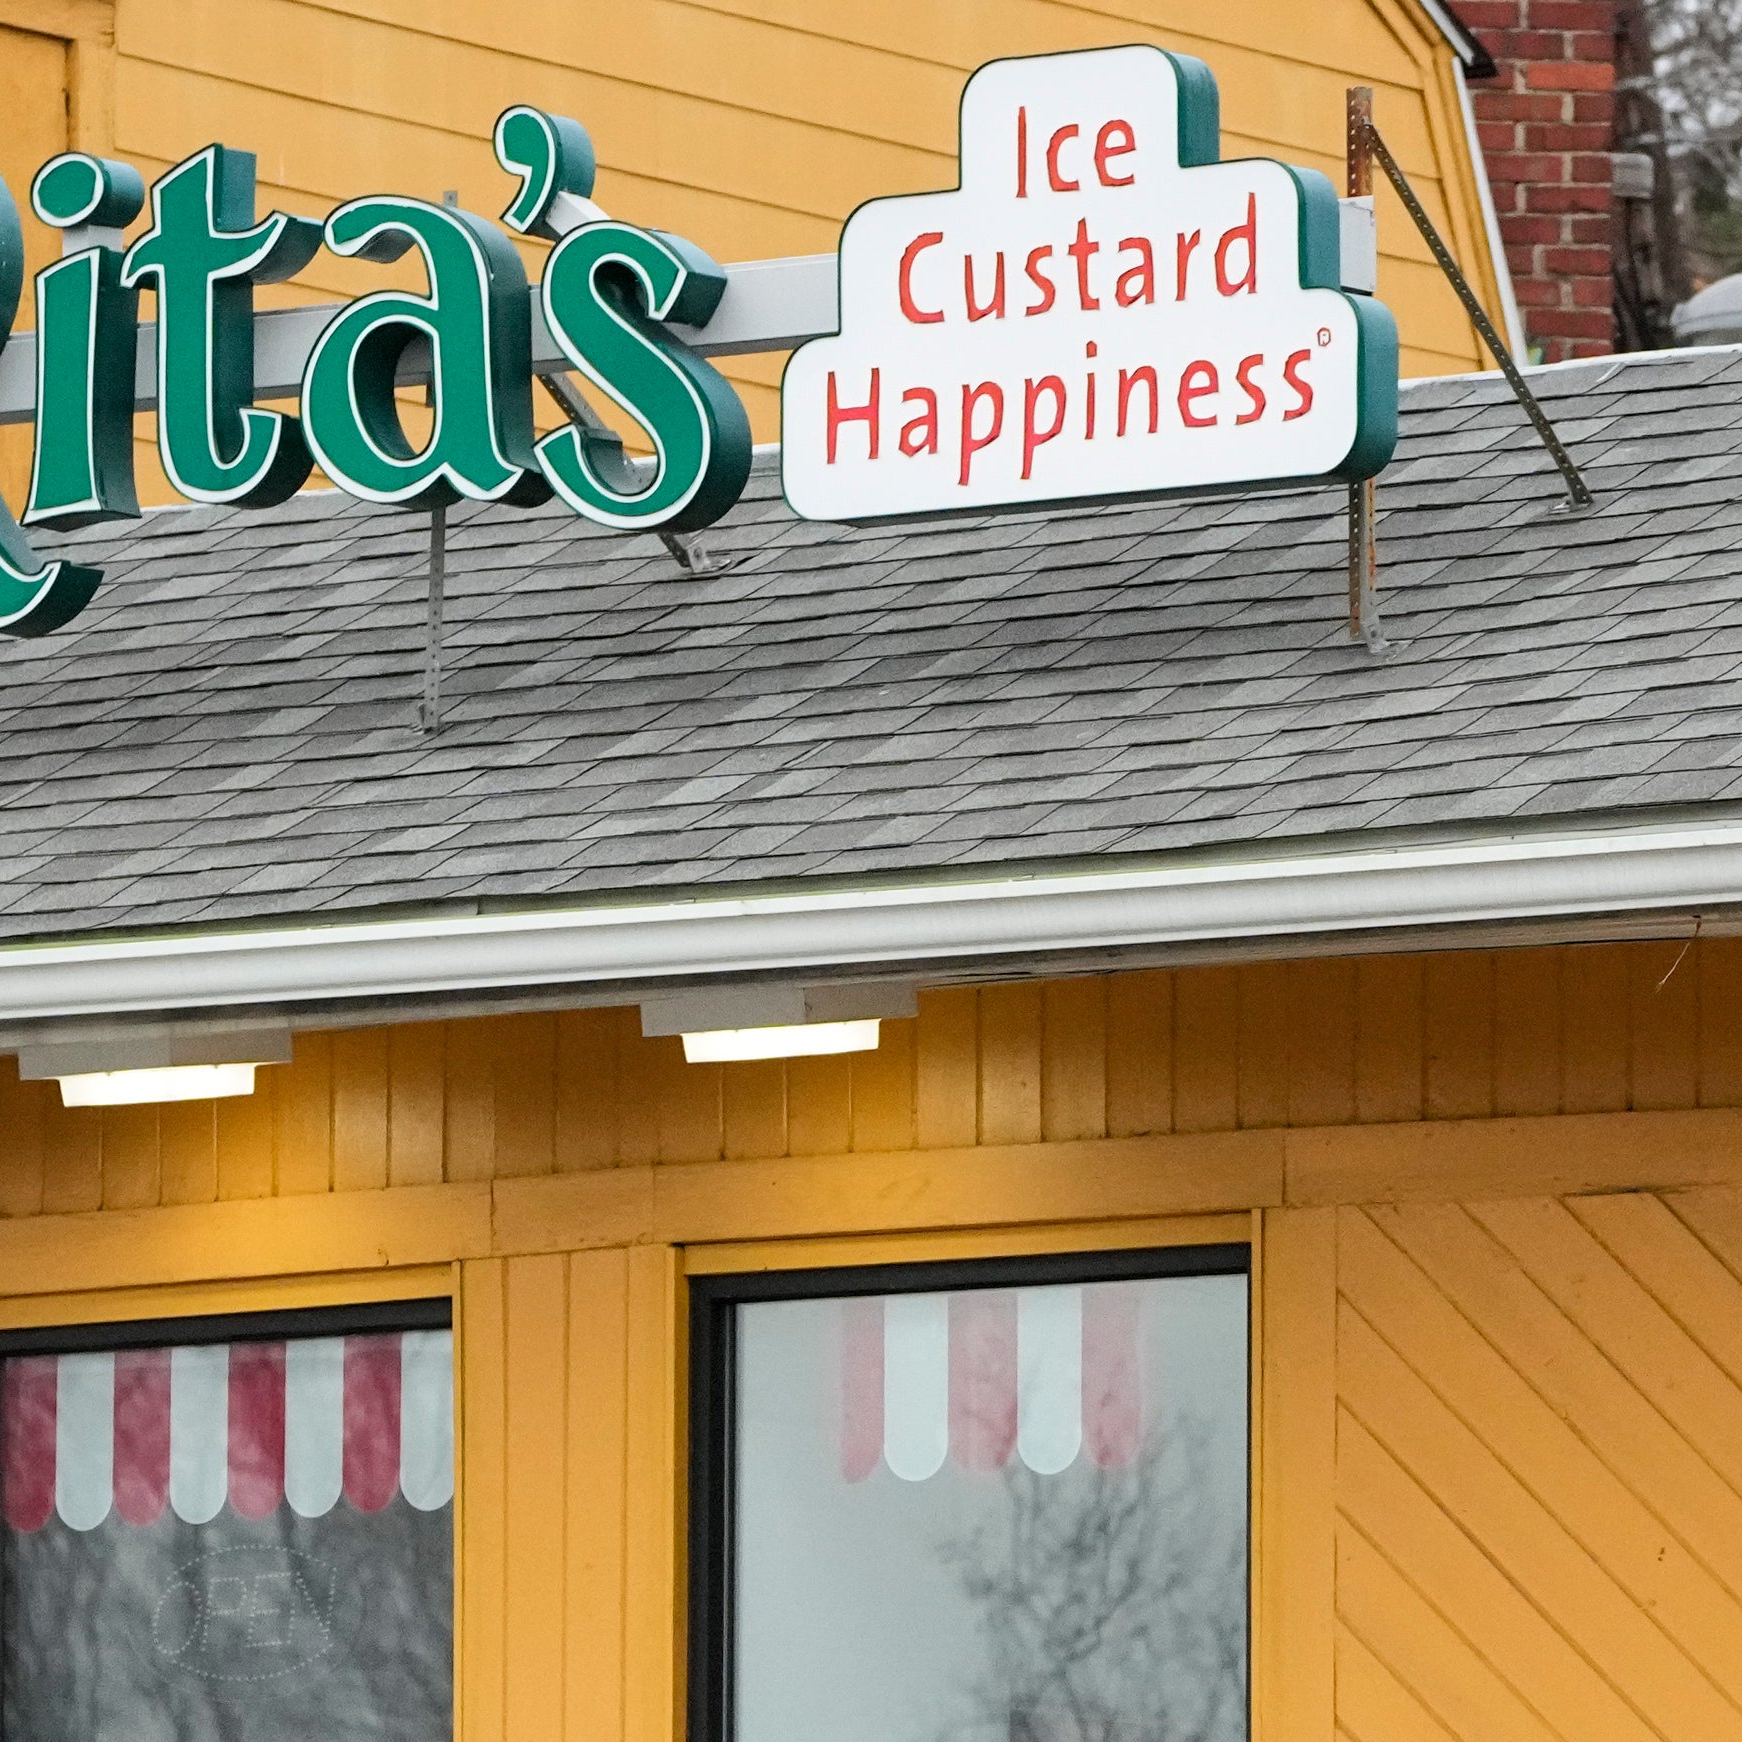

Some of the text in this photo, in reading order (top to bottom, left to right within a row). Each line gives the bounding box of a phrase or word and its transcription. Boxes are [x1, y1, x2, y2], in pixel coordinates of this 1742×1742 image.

[1015, 103, 1139, 199] Ice
[898, 193, 1260, 327] Custard
[152, 1565, 338, 1656] OPEN
